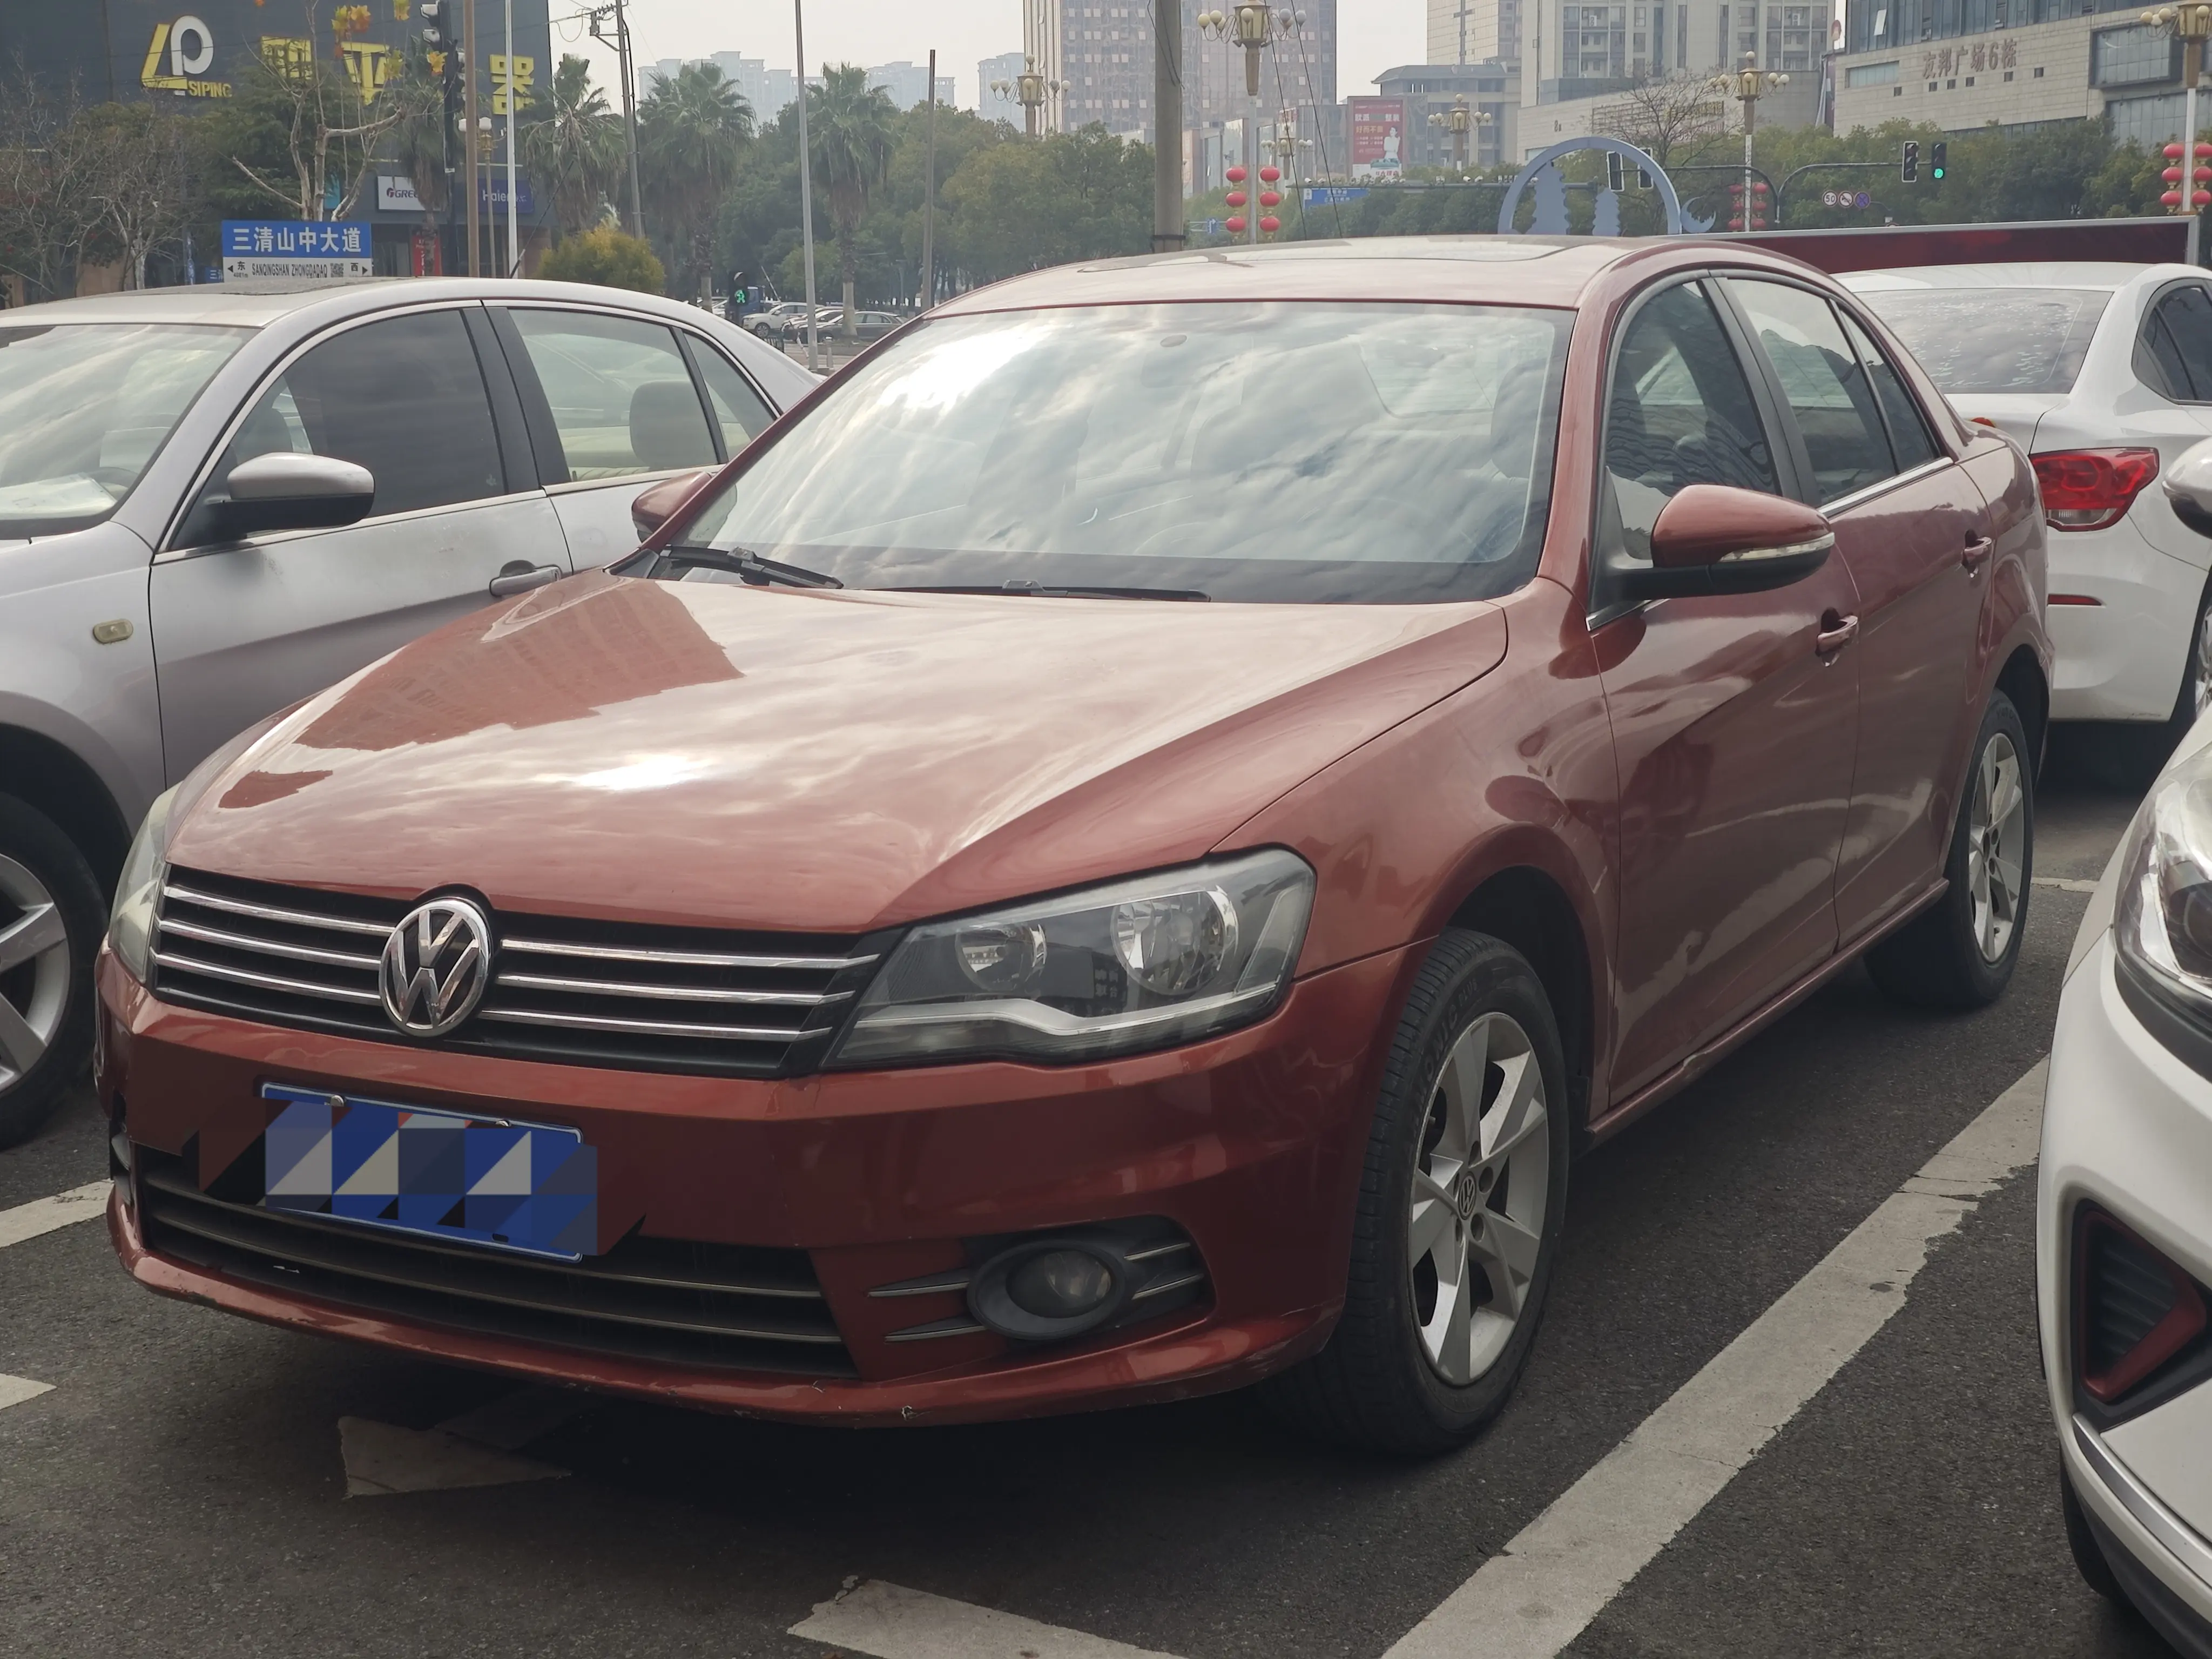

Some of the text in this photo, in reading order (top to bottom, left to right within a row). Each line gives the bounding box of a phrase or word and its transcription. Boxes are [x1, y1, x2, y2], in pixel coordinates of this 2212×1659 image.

[189, 82, 232, 97] SIPING
[233, 226, 361, 253] 三清山中大道
[238, 261, 246, 271] 东
[252, 263, 327, 279] SANQINGSHAN ZHONGDADAO
[350, 262, 358, 272] 西
